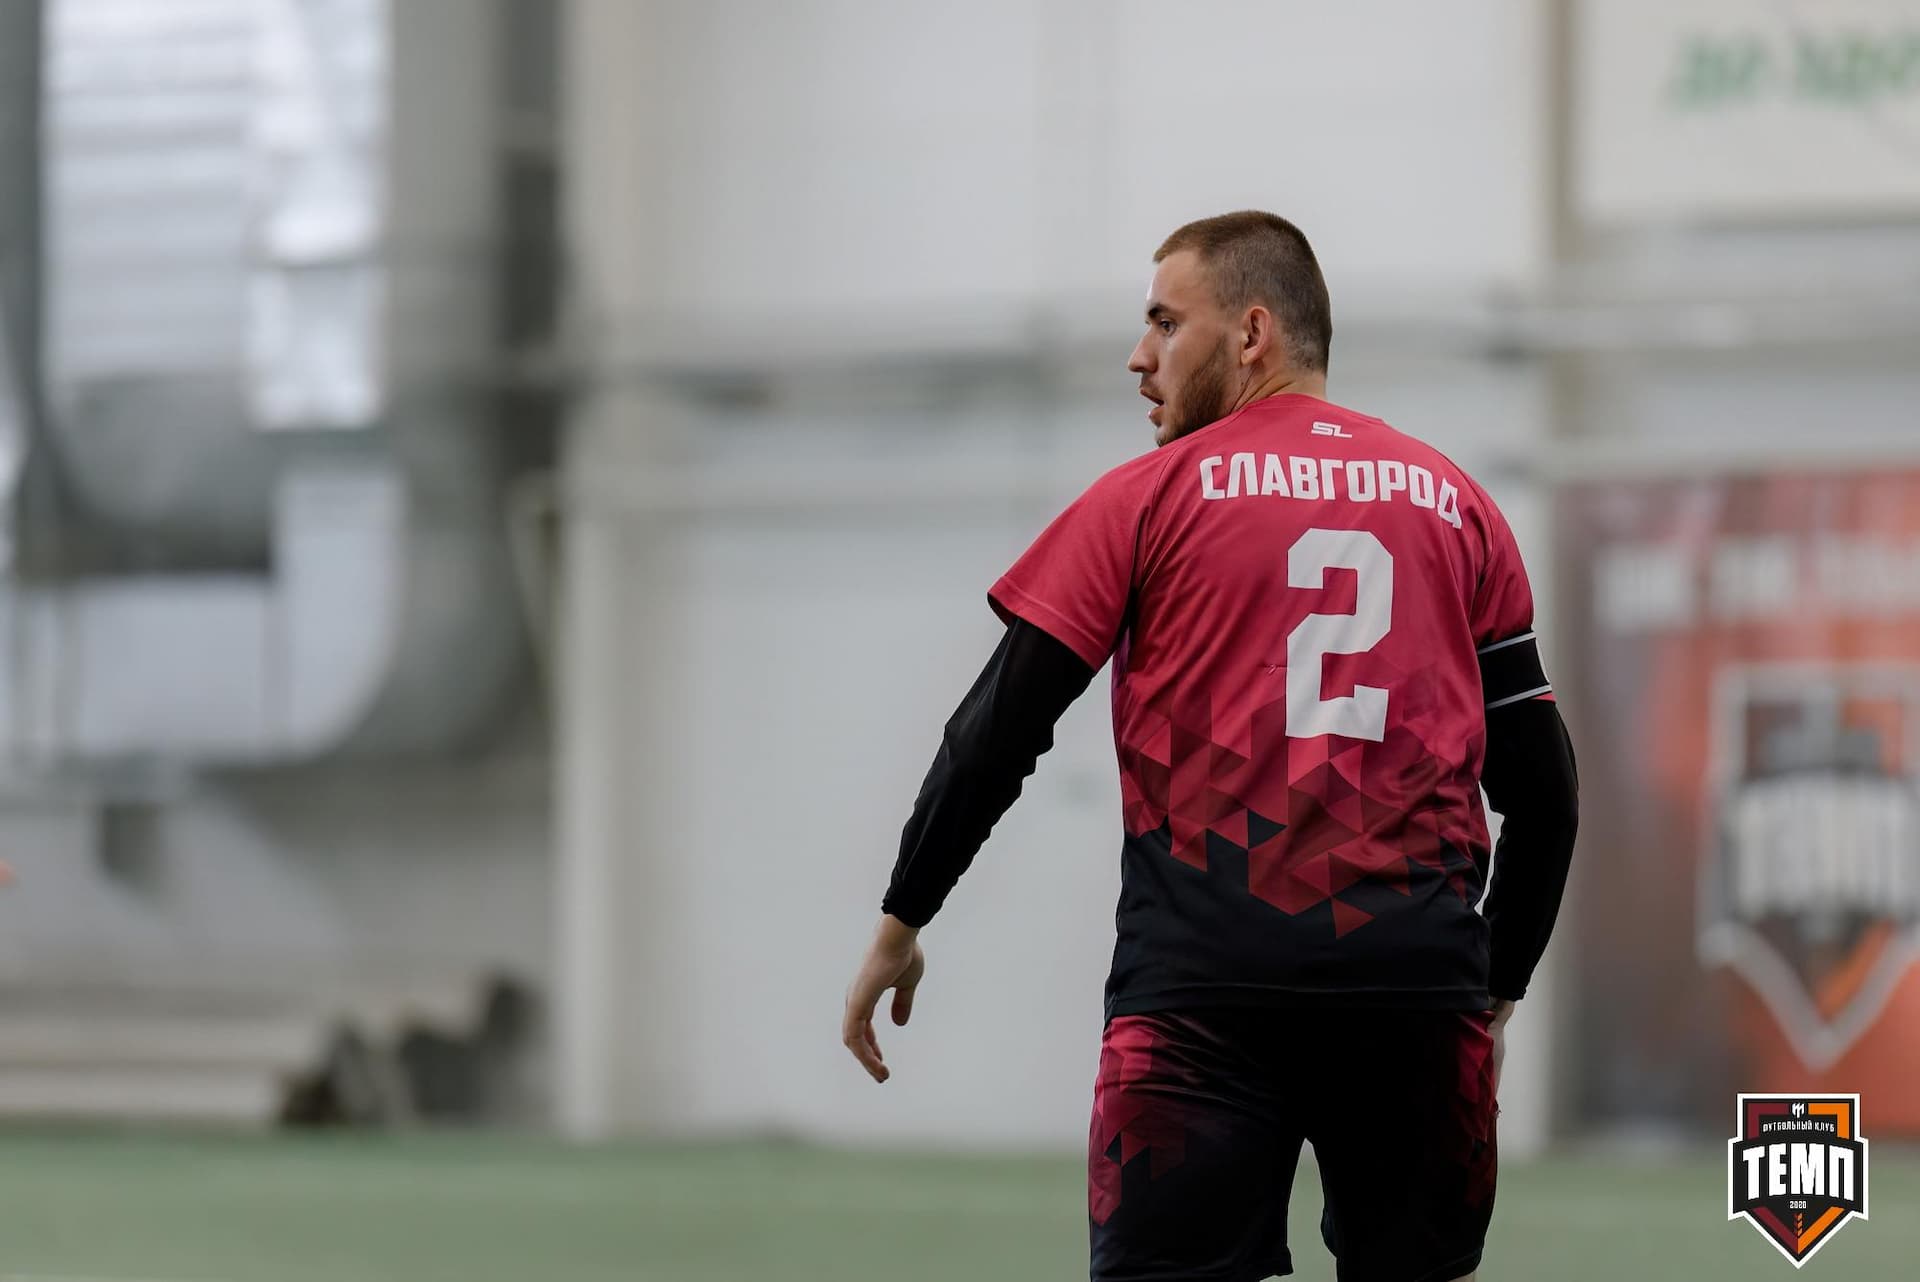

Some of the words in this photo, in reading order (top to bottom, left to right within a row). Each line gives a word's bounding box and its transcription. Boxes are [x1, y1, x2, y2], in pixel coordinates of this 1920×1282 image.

[1311, 421, 1353, 438] SL
[1199, 452, 1462, 529] СЛАВГОРОД
[1285, 528, 1393, 742] 2
